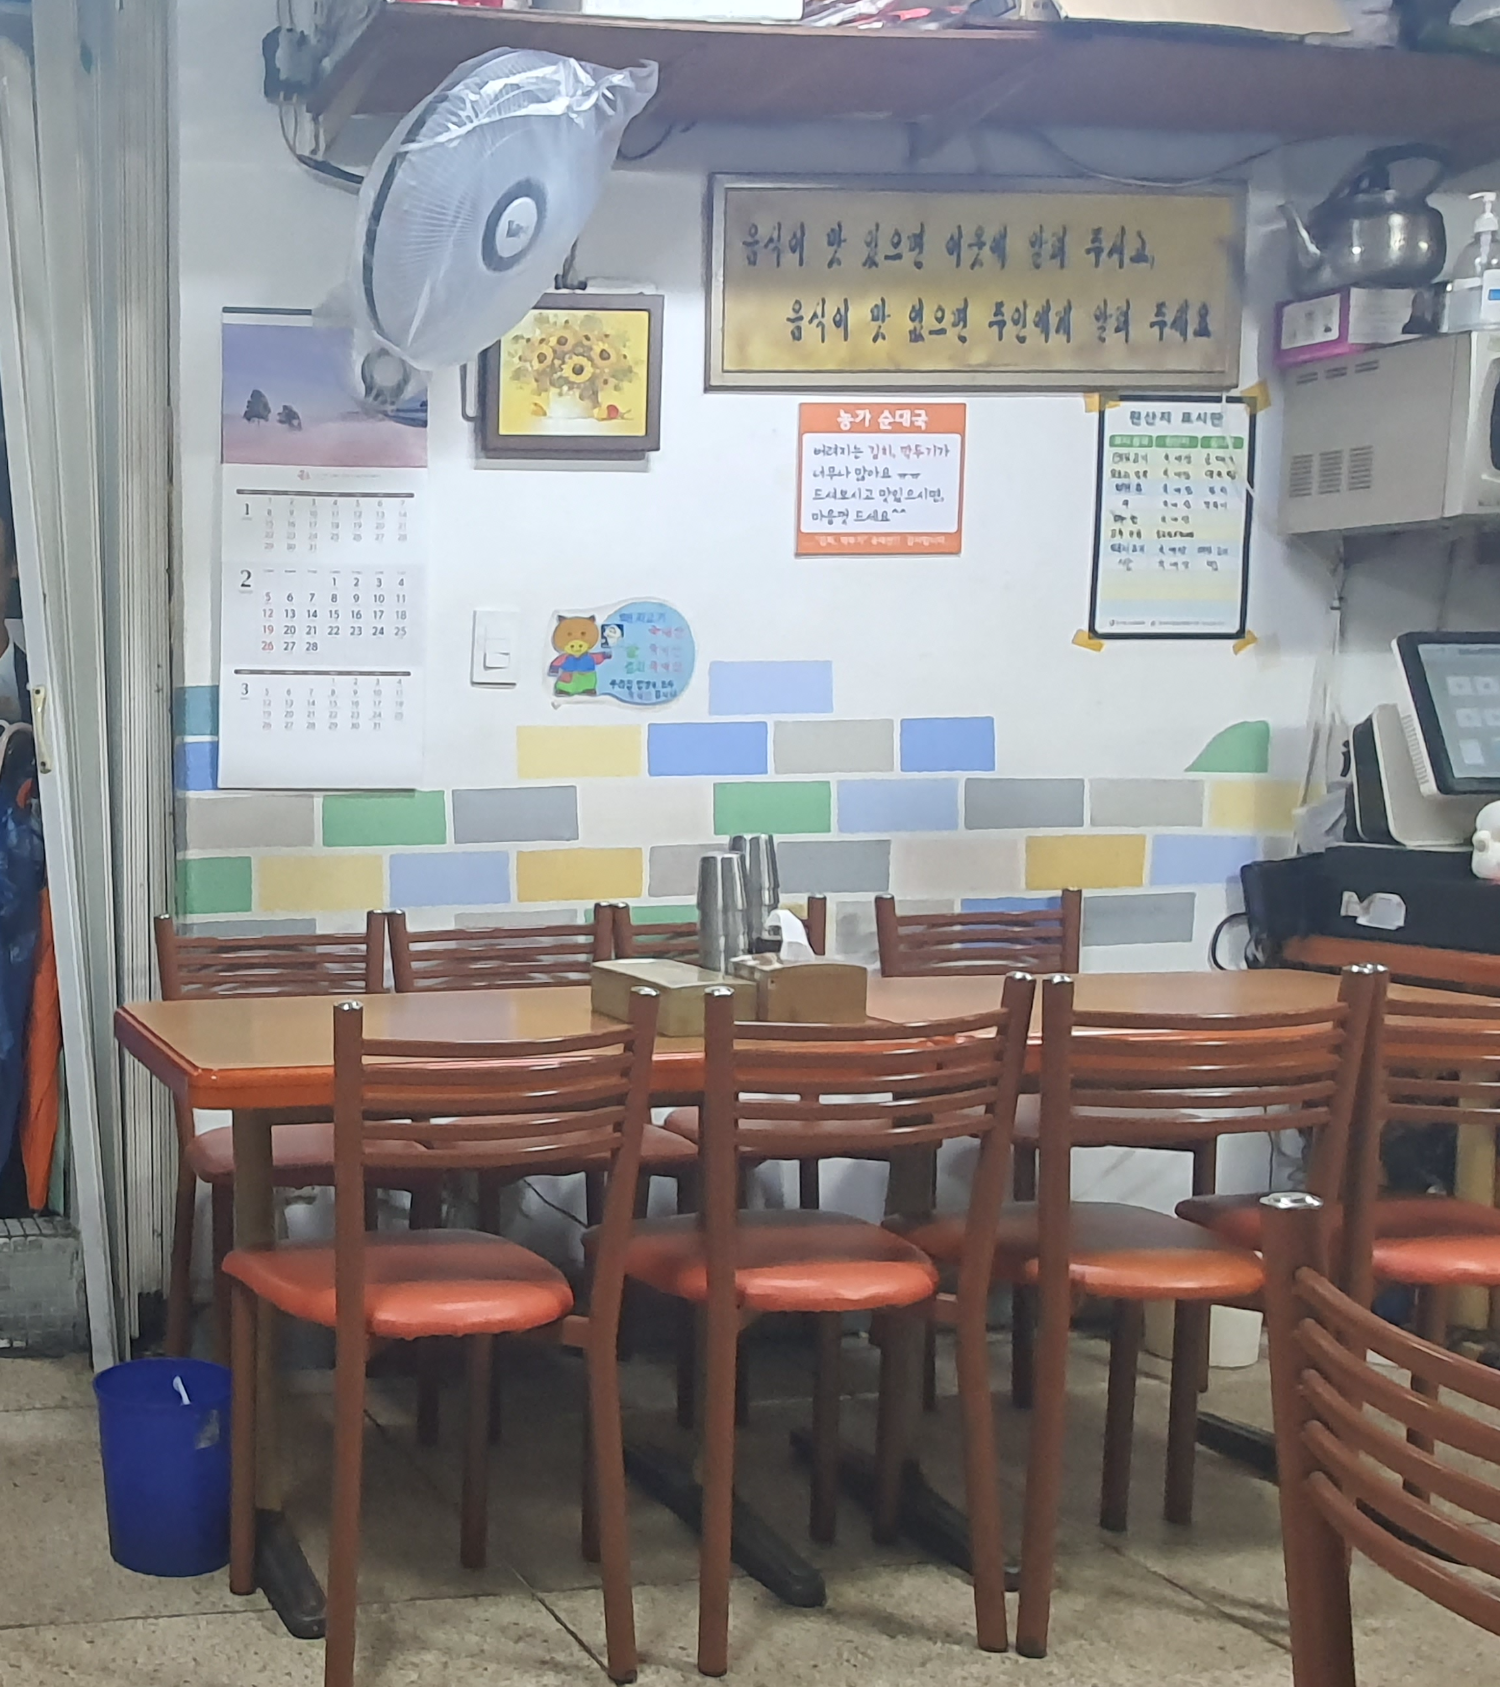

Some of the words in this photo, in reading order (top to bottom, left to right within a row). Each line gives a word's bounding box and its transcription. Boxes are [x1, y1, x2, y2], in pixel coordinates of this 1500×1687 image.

[743, 222, 805, 268] 음식이
[827, 223, 846, 268] 맛
[864, 223, 925, 269] 있으면
[946, 224, 1007, 270] 이웃에
[787, 299, 849, 343] 음식이
[871, 298, 890, 343] 맛
[908, 299, 968, 344] 없으면
[989, 300, 1072, 344] 주인에게
[1151, 300, 1211, 344] 주세요
[837, 409, 870, 430] 농가
[878, 410, 928, 430] 순대국
[1130, 411, 1171, 426] 원산지
[813, 444, 863, 459] 버려지는
[855, 466, 891, 481] 많아요
[245, 503, 249, 515] 1
[240, 570, 251, 588] 2
[333, 577, 336, 586] 1
[354, 578, 359, 587] 2
[376, 578, 382, 587] 3
[399, 578, 404, 586] 4
[265, 592, 270, 601] 5
[287, 593, 293, 602] 6
[310, 593, 315, 602] 7
[331, 594, 337, 603] 8
[353, 594, 359, 602] 9
[374, 594, 384, 603] 10
[397, 594, 406, 603] 11
[263, 609, 273, 618] 12
[285, 609, 295, 618] 13
[307, 609, 317, 618] 14
[329, 610, 339, 619] 15
[351, 610, 362, 619] 16
[374, 610, 384, 619] 17
[396, 610, 406, 619] 18
[263, 625, 274, 634] 19
[284, 625, 296, 635] 20
[306, 626, 316, 635] 21
[328, 626, 340, 635] 22
[350, 626, 362, 635] 23
[372, 626, 384, 635] 24
[394, 626, 407, 636] 25
[262, 641, 274, 651] 26
[284, 642, 295, 651] 27
[306, 642, 318, 651] 28
[241, 683, 248, 695] 3
